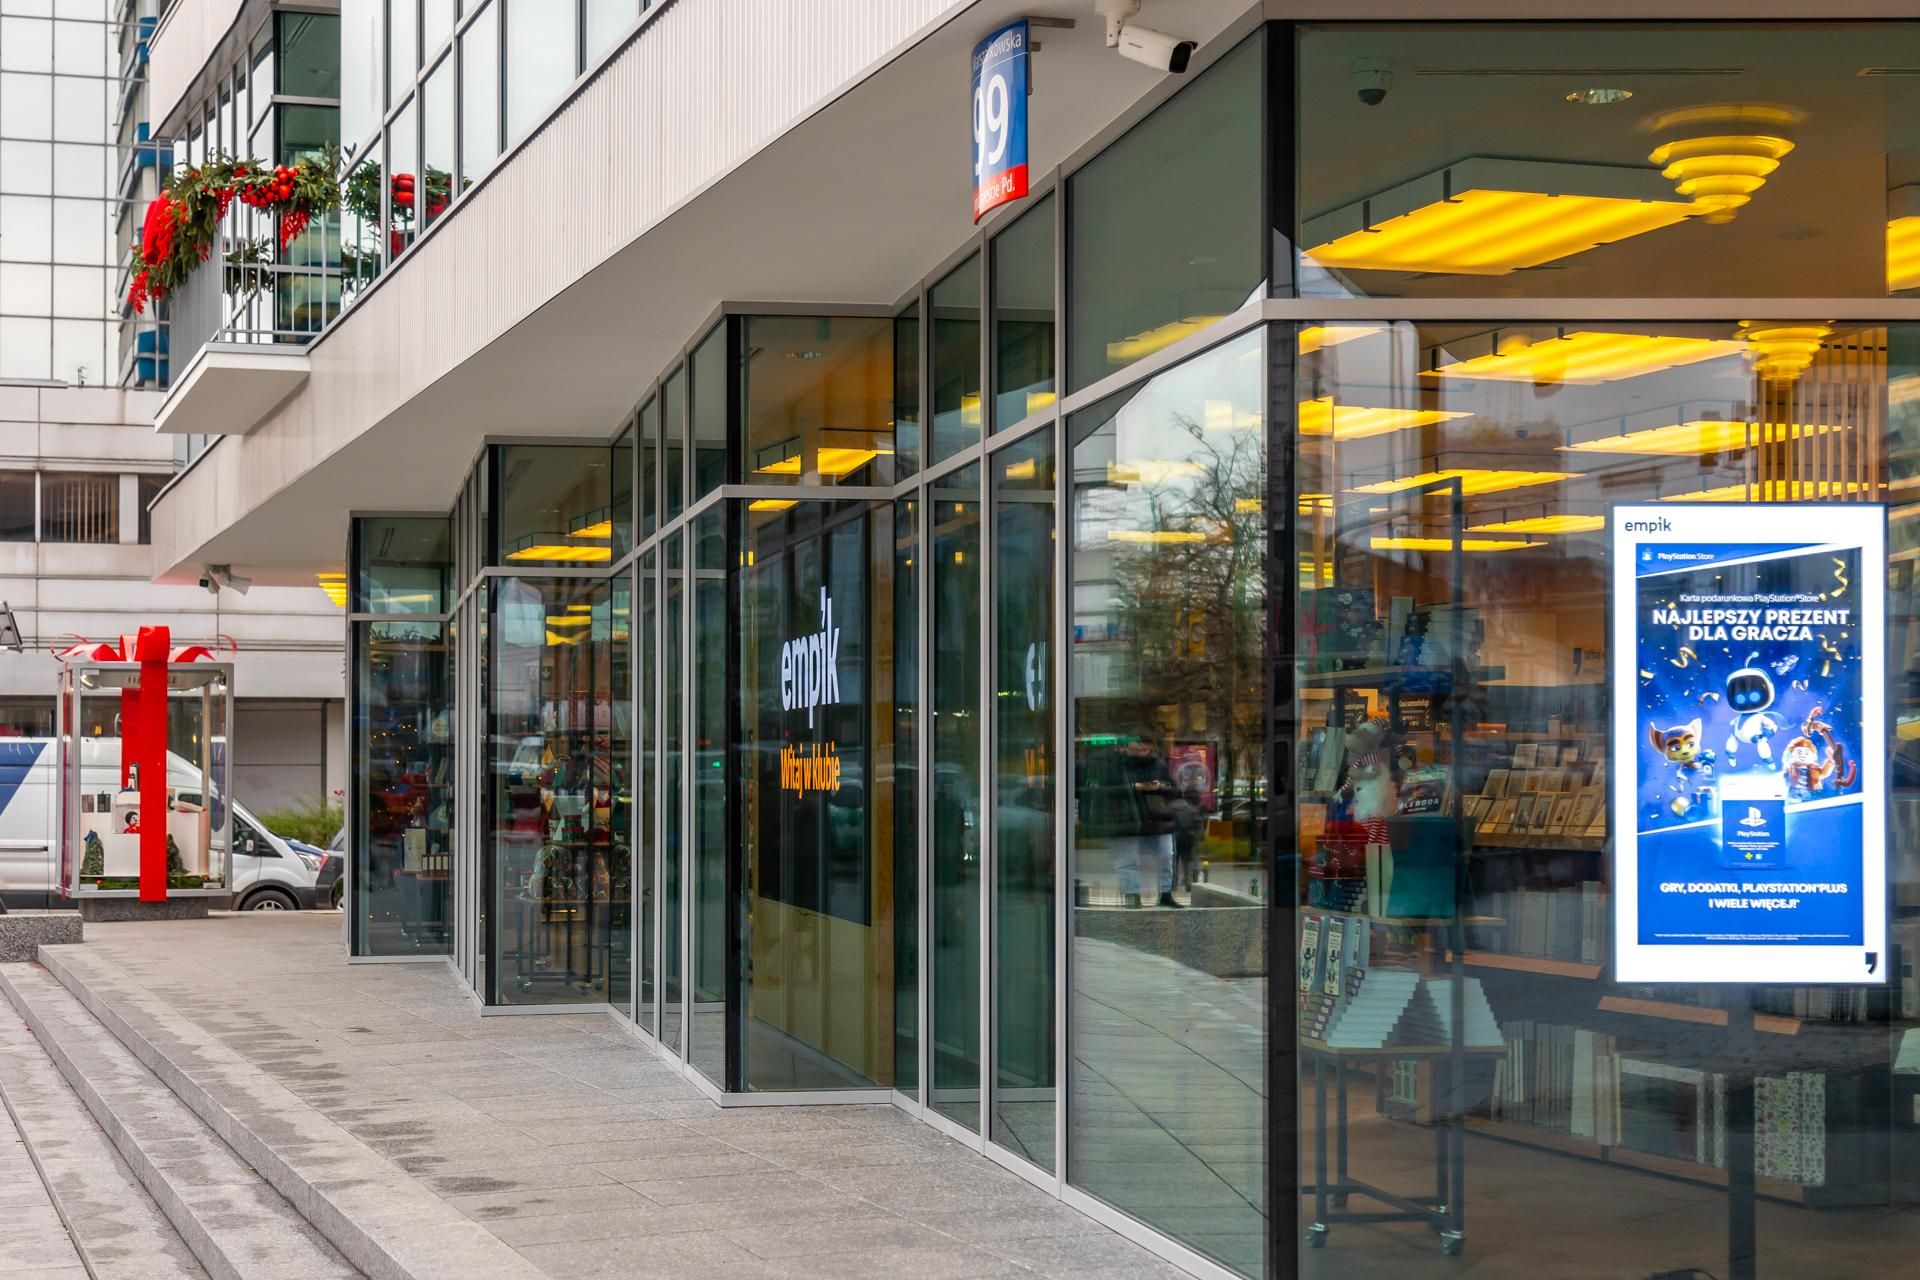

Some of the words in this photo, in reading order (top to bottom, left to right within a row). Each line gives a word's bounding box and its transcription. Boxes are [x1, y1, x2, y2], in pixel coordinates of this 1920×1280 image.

[973, 74, 1009, 176] 99
[1002, 173, 1016, 195] Pd.
[1624, 516, 1672, 535] empik
[1657, 552, 1697, 562] PlayStation
[1697, 552, 1715, 560] Store
[1680, 594, 1700, 602] Karta
[1701, 594, 1753, 603] podarunkowa
[1652, 609, 1762, 625] NAJLEPSZY
[1765, 609, 1849, 625] PREZENT
[1689, 626, 1728, 640] DLA
[1731, 626, 1813, 640] GRACZA
[781, 586, 840, 729] empik
[780, 743, 803, 800] Witaj
[803, 757, 812, 790] w
[812, 741, 840, 791] klubie
[1660, 882, 1686, 894] GRY,
[1687, 882, 1741, 894] DODATKI,
[1820, 883, 1848, 893] PLUS
[1714, 899, 1749, 909] WIELE
